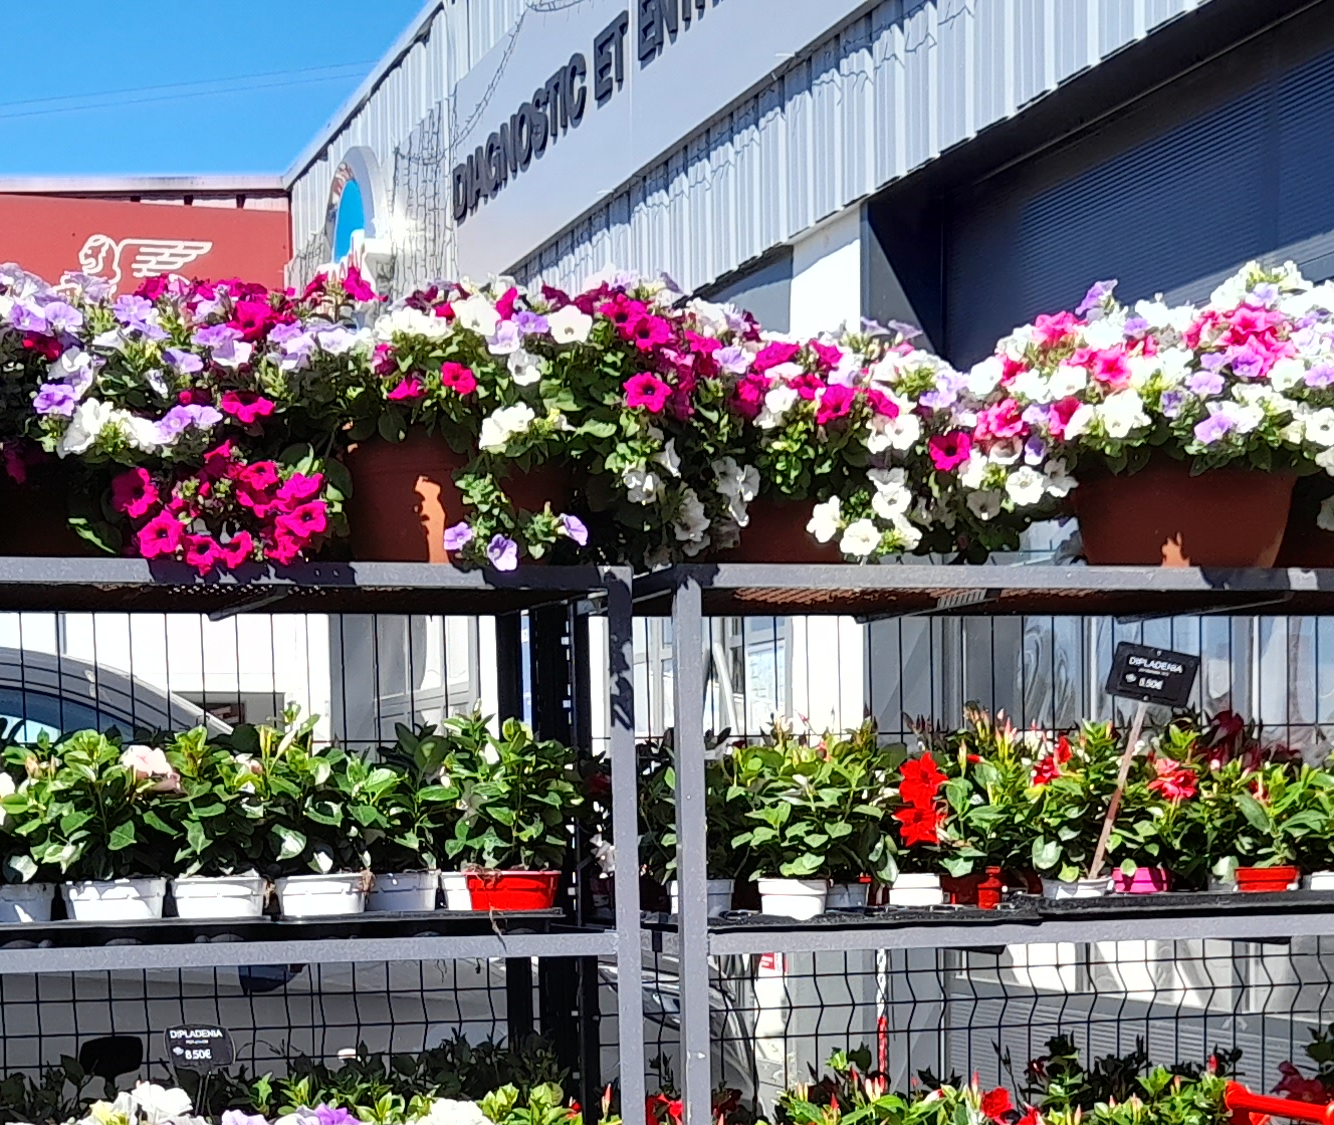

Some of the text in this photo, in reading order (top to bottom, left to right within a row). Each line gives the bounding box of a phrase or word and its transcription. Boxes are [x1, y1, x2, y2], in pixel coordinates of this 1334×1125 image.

[453, 53, 587, 222] DIAGNOSTIC
[593, 10, 630, 101] ET
[169, 1029, 223, 1039] DIPLADENIA
